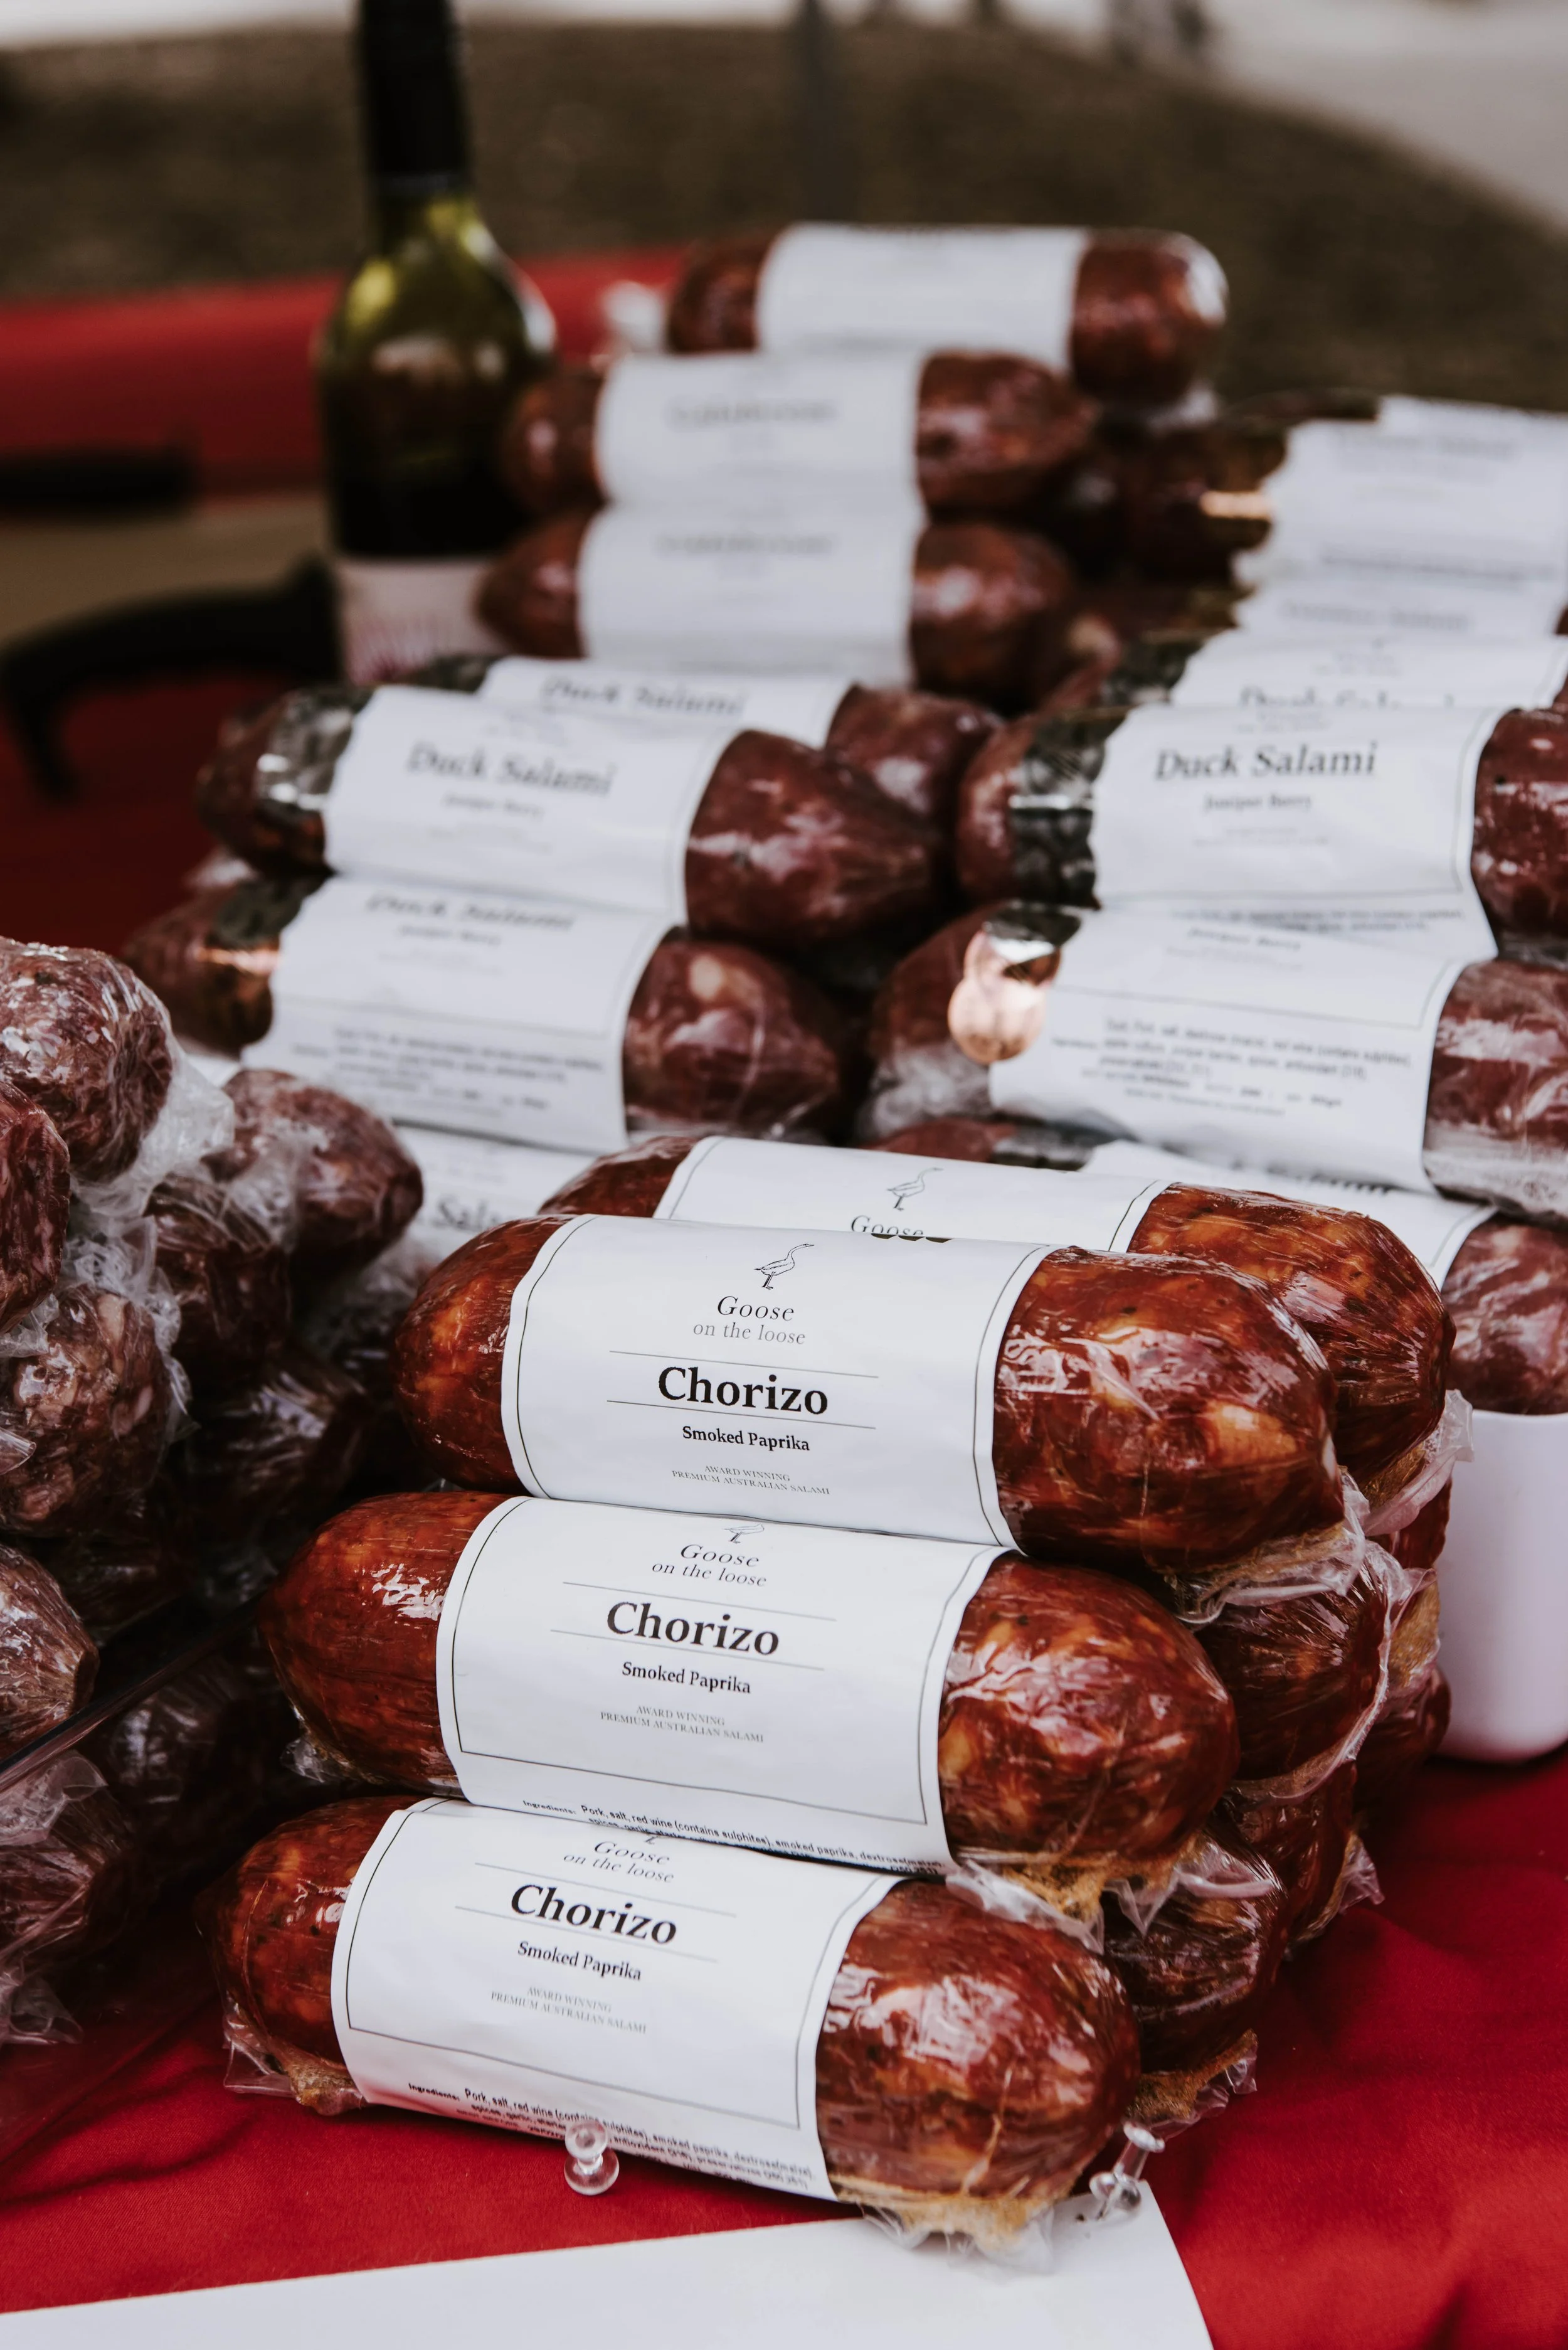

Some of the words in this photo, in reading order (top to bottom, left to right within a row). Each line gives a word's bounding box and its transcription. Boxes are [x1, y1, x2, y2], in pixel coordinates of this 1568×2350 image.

[1154, 742, 1239, 782] Duck
[1251, 740, 1379, 779] Salami
[717, 1295, 794, 1321] Goose
[693, 1322, 716, 1336] on
[723, 1322, 751, 1339] the
[757, 1325, 805, 1344] loose
[659, 1366, 828, 1415] Chorizo
[682, 1425, 744, 1445] Smoked
[747, 1432, 810, 1451] Paprika
[672, 1470, 720, 1483] PREMIUM
[723, 1477, 788, 1491] AUSTRALIAN
[790, 1484, 830, 1494] SALAMI
[704, 1465, 741, 1475] AWARD
[743, 1469, 790, 1481] WINNING
[680, 1544, 760, 1567] Goose
[652, 1563, 675, 1575] on
[682, 1564, 712, 1580] the
[718, 1568, 767, 1587] loose
[607, 1601, 779, 1656] Chorizo
[622, 1661, 685, 1684] Smoked
[689, 1671, 751, 1693] Paprika
[600, 1711, 650, 1726] PREMIUM
[654, 1720, 721, 1737] AUSTRALIAN
[723, 1730, 764, 1743] SALAMI
[636, 1706, 673, 1718] AWARD
[676, 1711, 725, 1725] WINNING
[581, 1804, 608, 1819] Pork,
[610, 1811, 630, 1822] salt,
[632, 1815, 648, 1824] red
[650, 1817, 673, 1828] wine
[674, 1820, 719, 1837] (contains
[775, 1839, 814, 1853] smoked
[817, 1846, 858, 1861] paprika,
[594, 1841, 670, 1866] Goose
[563, 1854, 586, 1865] on
[592, 1858, 622, 1873] the
[627, 1863, 674, 1883] loose
[511, 1885, 676, 1944] Chorizo
[517, 1941, 580, 1967] Smoked
[583, 1953, 641, 1981] Paprika
[490, 1991, 538, 2010] PREMIUM
[541, 2001, 604, 2025] AUSTRALIAN
[607, 2016, 647, 2034] SALAMI
[527, 1987, 562, 2002] AWARD
[564, 1994, 612, 2013] WINNING
[465, 2088, 490, 2105] Pork,
[513, 2103, 529, 2112] red
[531, 2104, 553, 2117] wine
[653, 2134, 690, 2149] smoked
